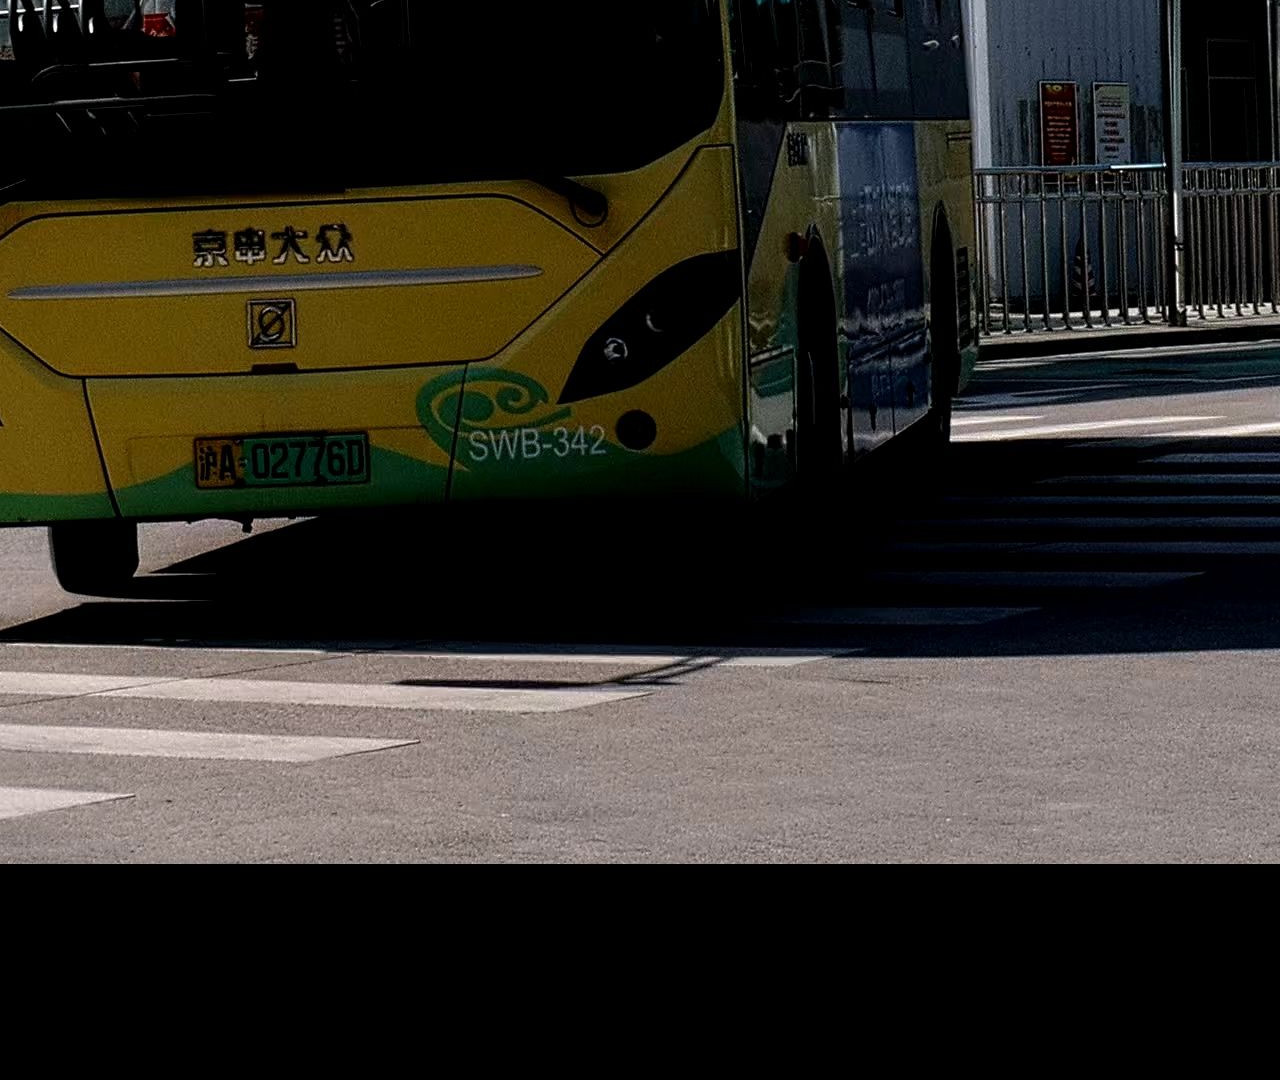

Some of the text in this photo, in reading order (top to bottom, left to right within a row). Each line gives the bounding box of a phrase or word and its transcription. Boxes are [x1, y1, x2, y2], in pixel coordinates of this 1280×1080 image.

[192, 223, 354, 268] 京申大众
[468, 423, 607, 462] SWB-342
